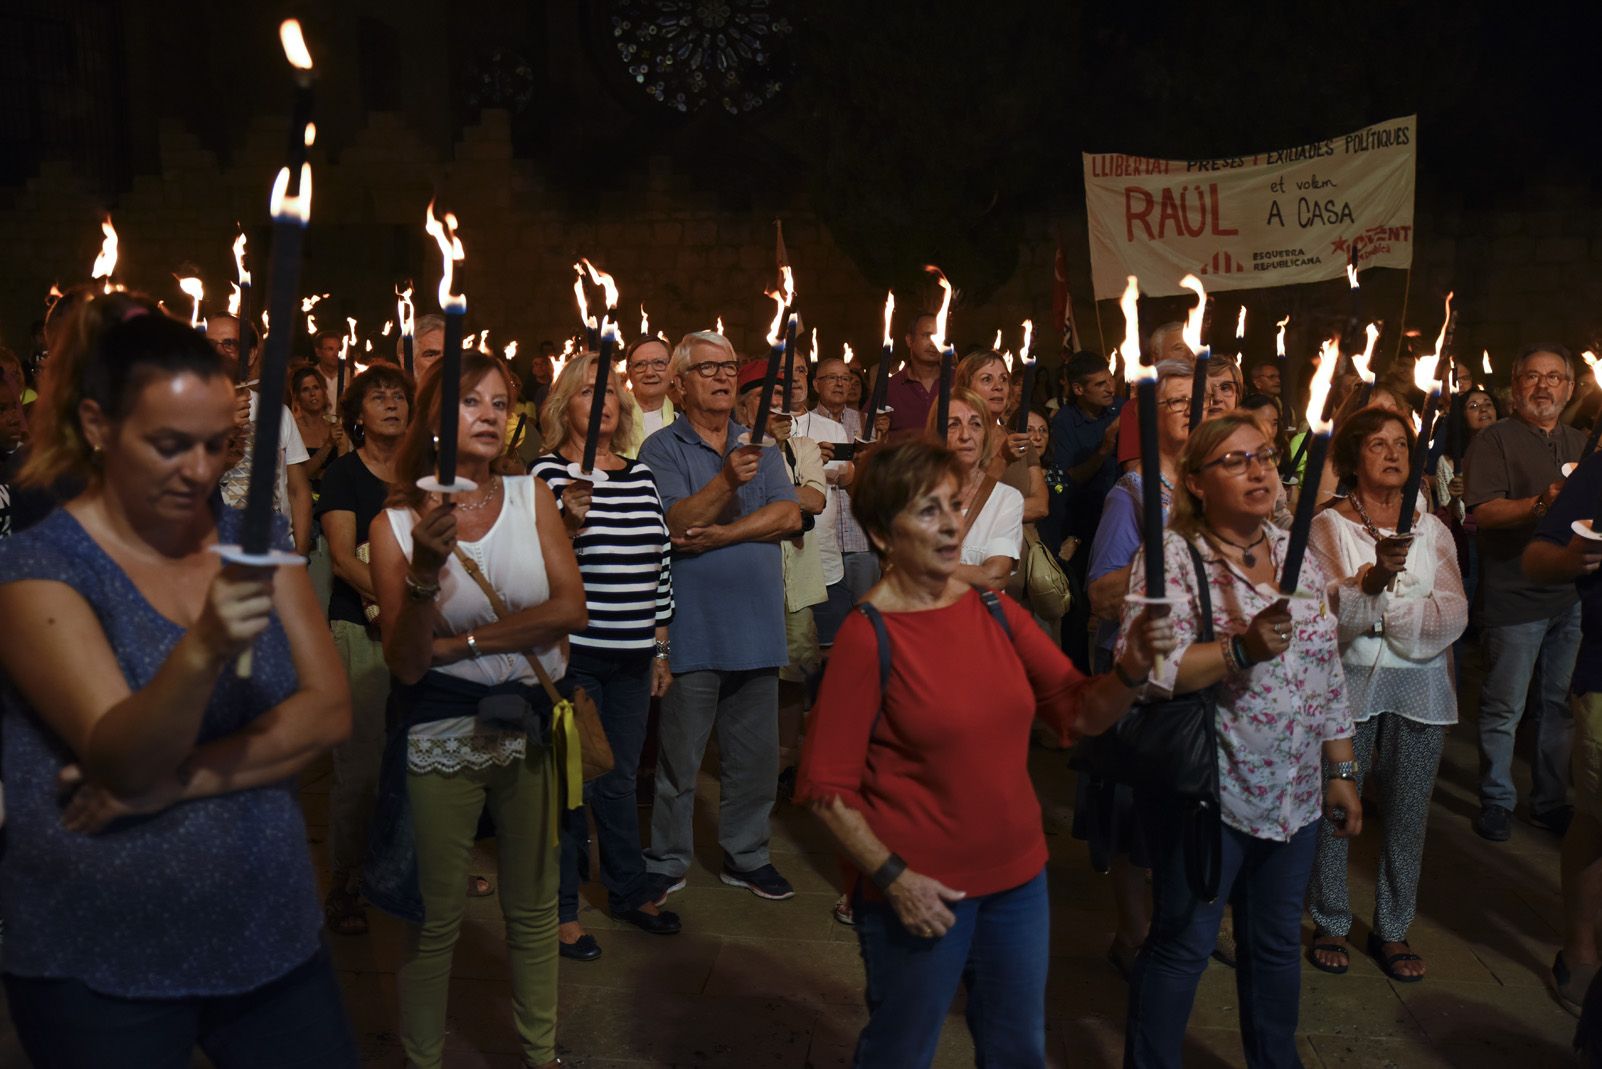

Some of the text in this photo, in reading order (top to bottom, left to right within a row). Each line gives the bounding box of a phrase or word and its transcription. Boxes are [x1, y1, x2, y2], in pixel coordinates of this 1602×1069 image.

[1093, 155, 1169, 177] LLIBERTAT
[1187, 158, 1244, 173] PRESES
[1267, 140, 1334, 165] EXILIADES
[1346, 127, 1409, 153] POLÍTIQUES
[1271, 174, 1337, 193] et volem
[1125, 183, 1239, 242] RAÜL
[1267, 197, 1354, 228] A CASA
[1253, 249, 1304, 261] ESQUERRA
[1254, 256, 1321, 271] REPUBLICANA
